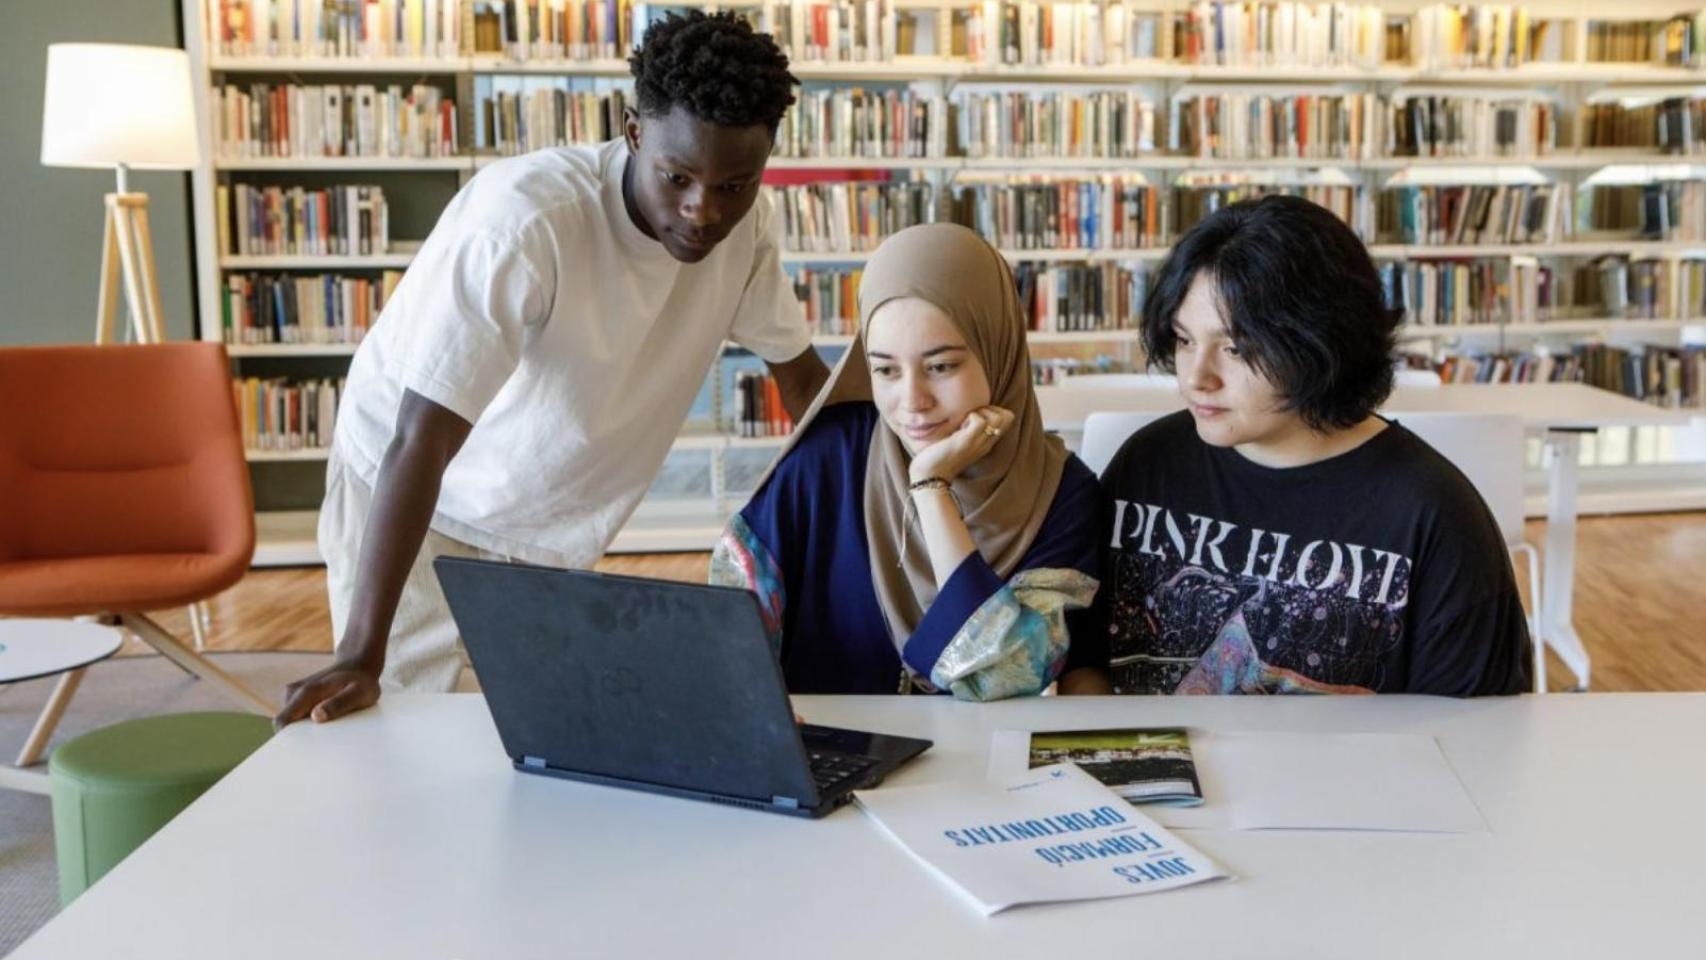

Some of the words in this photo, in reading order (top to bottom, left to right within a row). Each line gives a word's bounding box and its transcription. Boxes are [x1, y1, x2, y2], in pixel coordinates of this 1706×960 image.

[1109, 499, 1239, 574] PINK
[1240, 527, 1413, 609] FLOYD
[944, 805, 1127, 848] OPORTUNITATS
[1034, 831, 1163, 868] FORMACIÓ
[1113, 856, 1197, 884] JOVES
